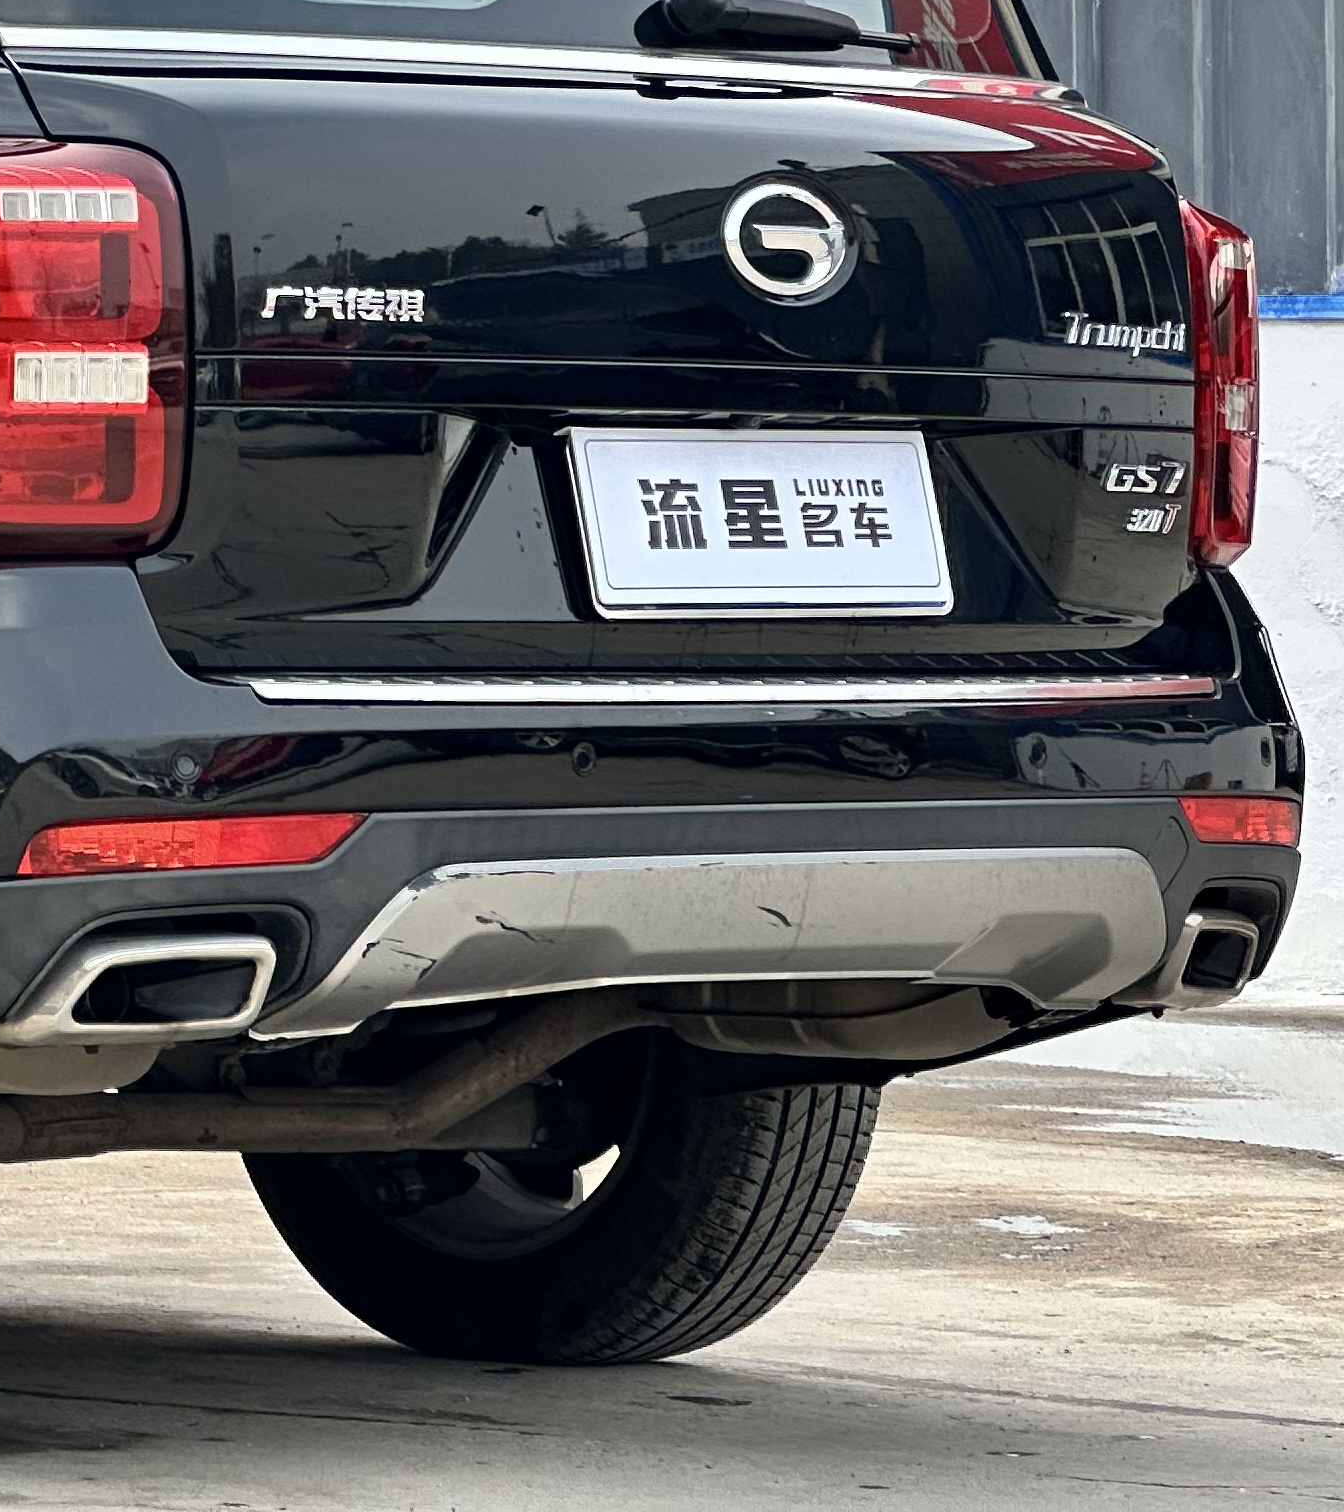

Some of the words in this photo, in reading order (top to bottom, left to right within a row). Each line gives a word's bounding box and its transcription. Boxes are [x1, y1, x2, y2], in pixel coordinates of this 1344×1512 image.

[261, 286, 426, 323] 广汽传祺
[1061, 310, 1187, 357] Trumpchi
[1101, 461, 1187, 494] GS7
[637, 478, 788, 550] 流星
